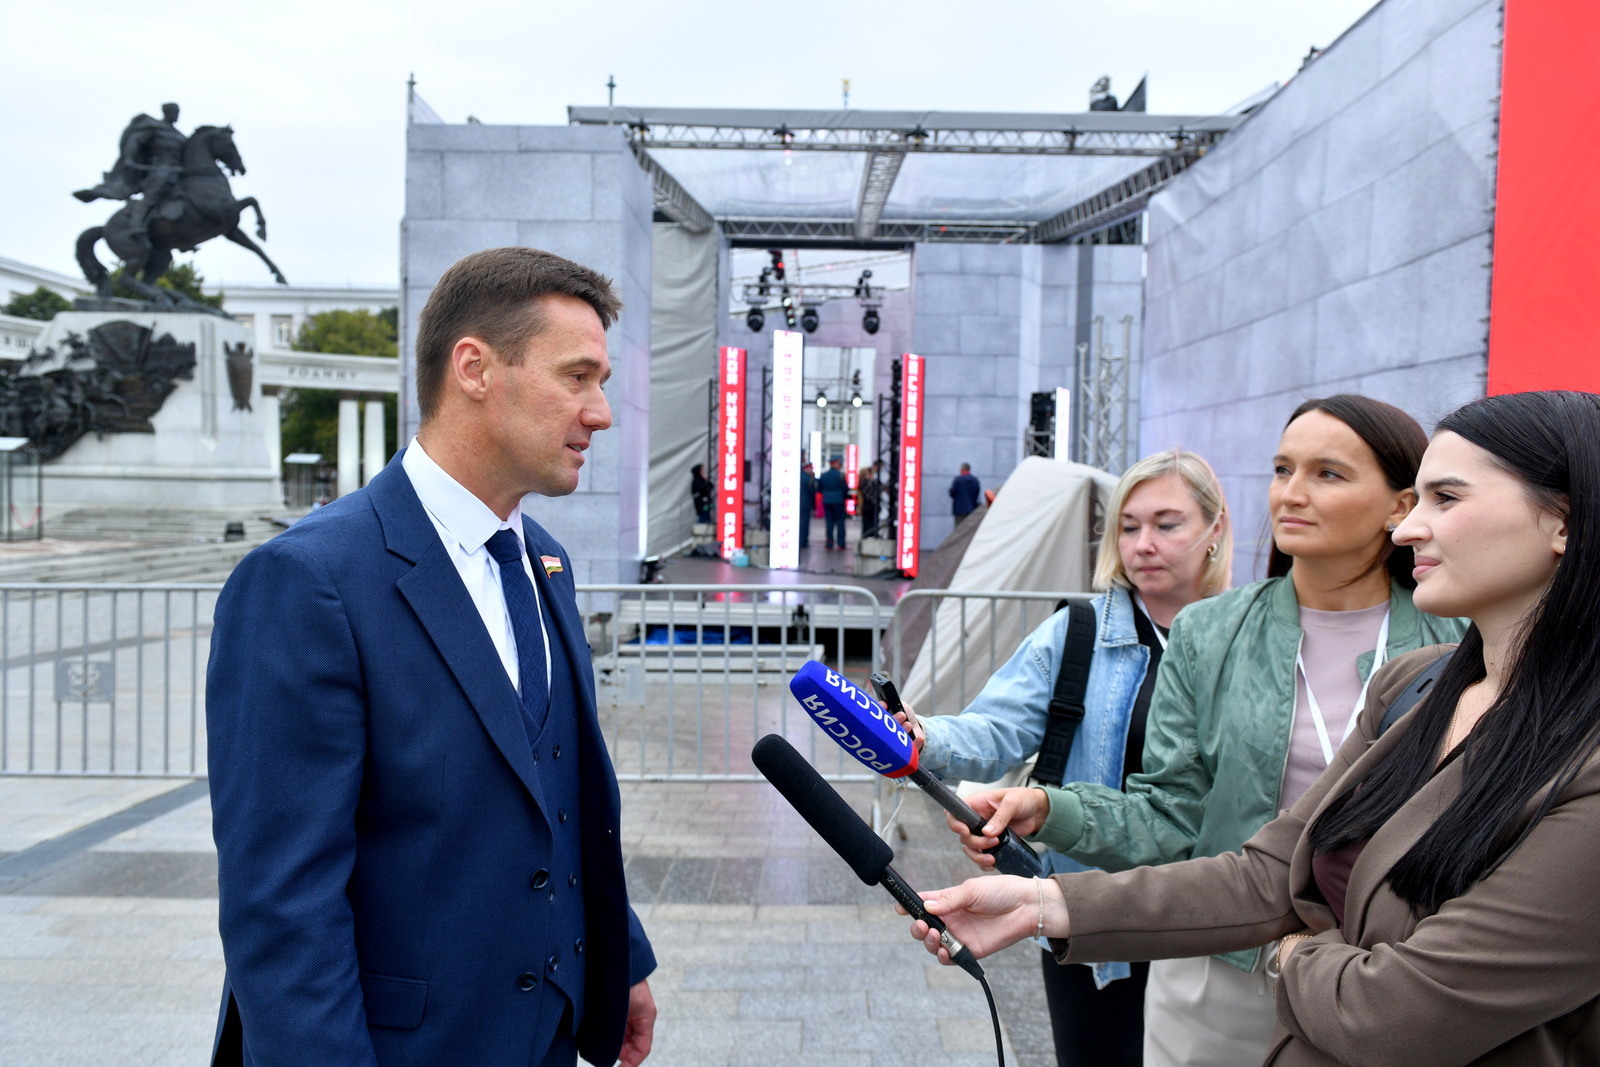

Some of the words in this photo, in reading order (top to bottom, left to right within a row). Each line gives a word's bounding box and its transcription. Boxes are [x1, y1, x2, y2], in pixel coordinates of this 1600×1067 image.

[902, 446, 916, 569] КУЛЬТУРЫ
[802, 694, 893, 771] РОССИЯ
[825, 669, 908, 747] РОССИЯ
